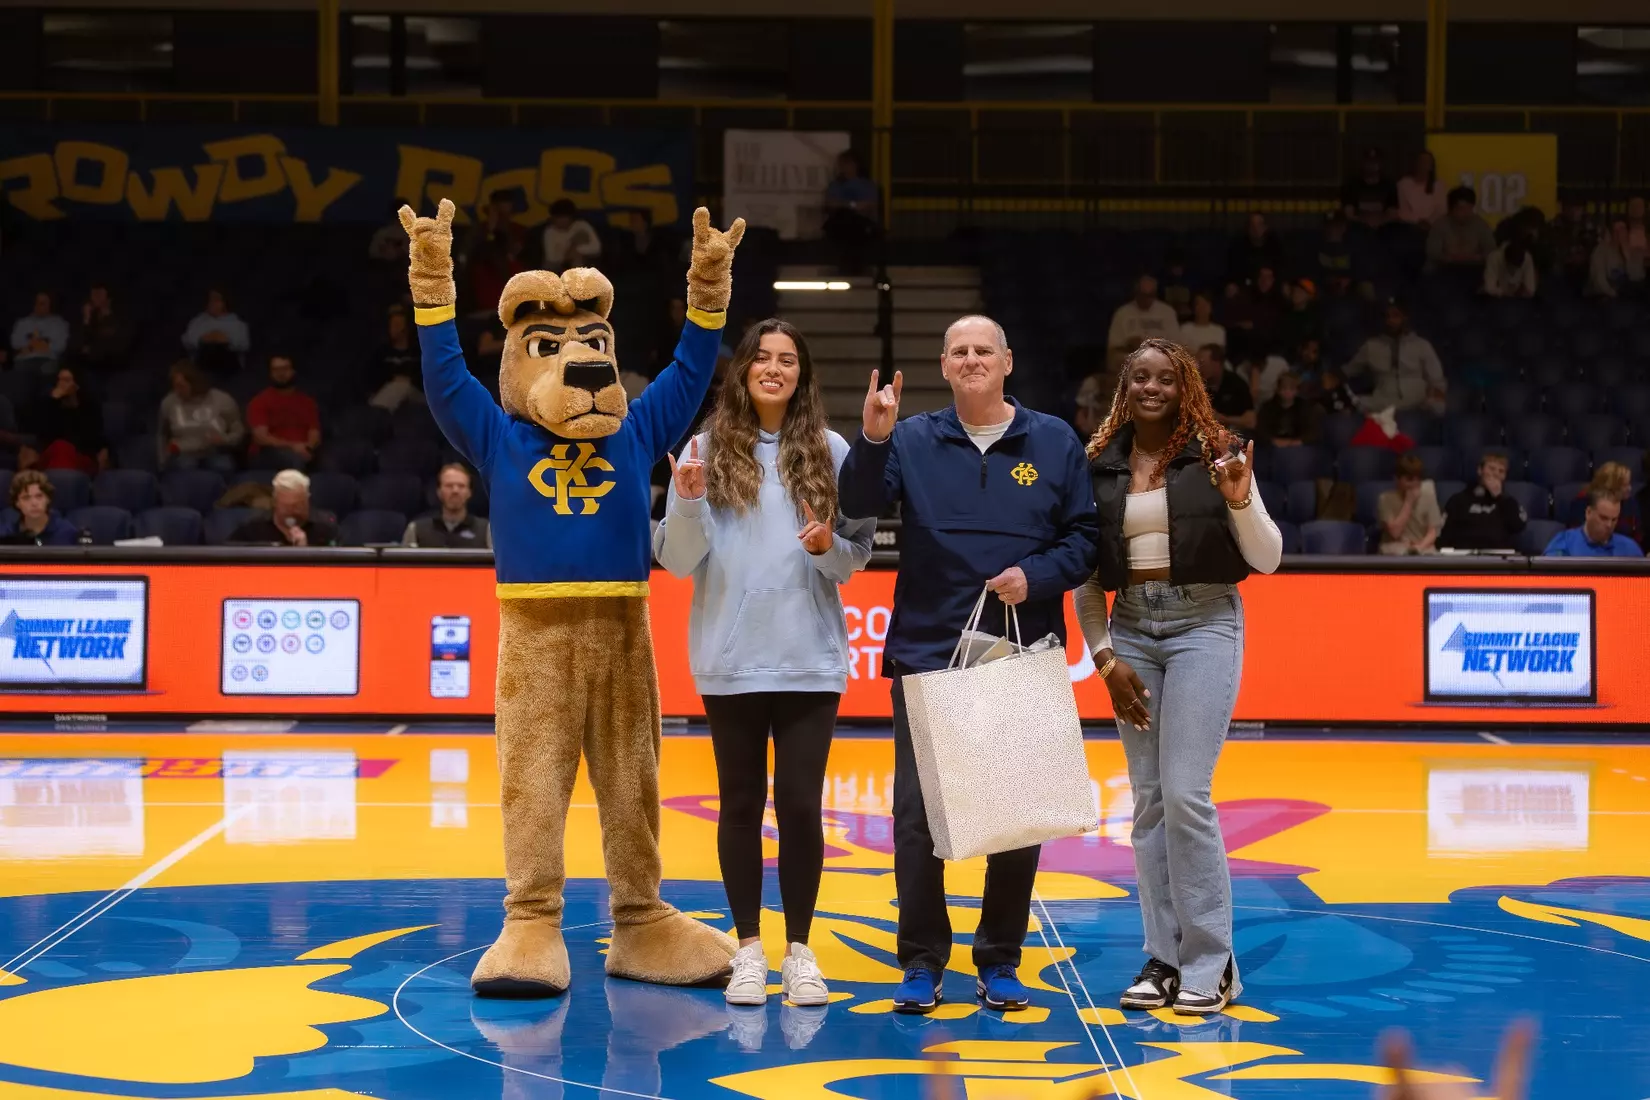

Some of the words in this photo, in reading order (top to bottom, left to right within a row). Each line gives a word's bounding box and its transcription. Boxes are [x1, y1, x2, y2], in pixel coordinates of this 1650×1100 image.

[0, 134, 360, 222] ROWDY
[395, 144, 679, 228] ROOS
[13, 636, 127, 658] NETWORK
[1463, 632, 1523, 648] SUMMIT
[1524, 632, 1580, 648] LEAGUE
[1461, 650, 1576, 672] NETWORK
